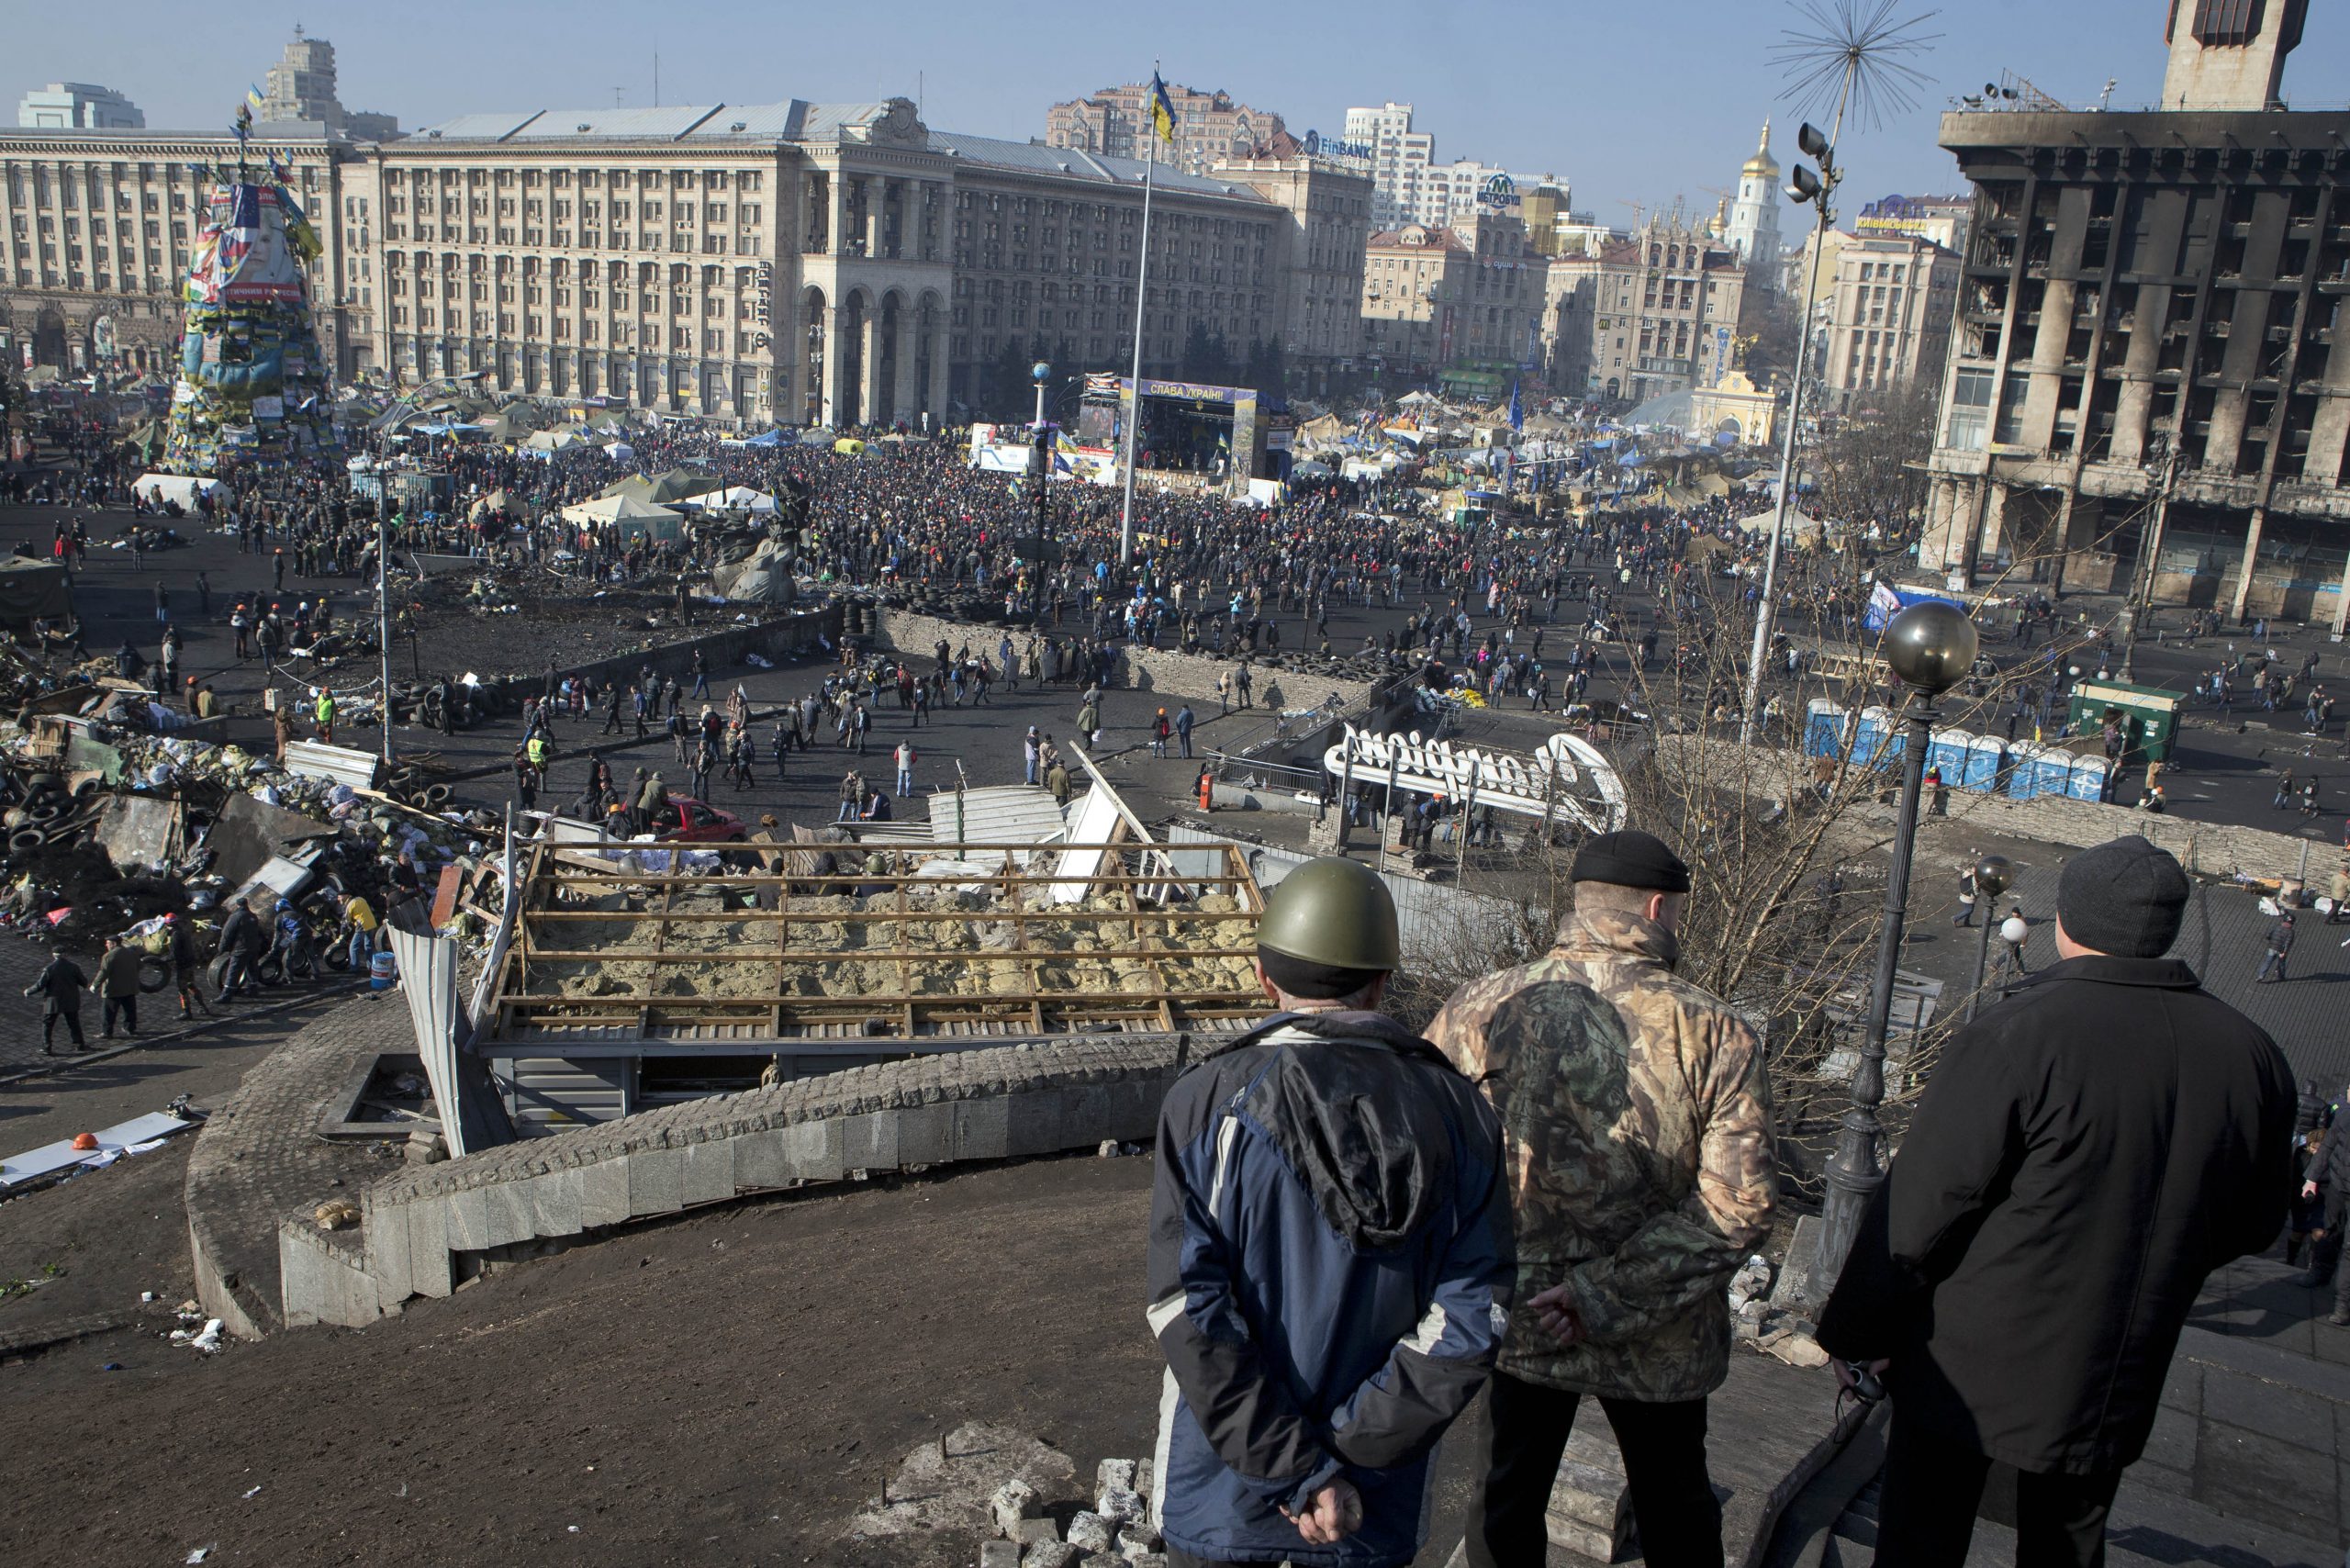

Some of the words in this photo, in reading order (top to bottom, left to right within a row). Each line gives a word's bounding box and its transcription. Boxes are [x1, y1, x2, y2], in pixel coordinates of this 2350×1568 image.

[1321, 137, 1372, 161] FinBANK
[1476, 191, 1521, 207] МЕТРОБУД
[1150, 384, 1183, 397] СЛАВА
[1186, 387, 1224, 401] УКРАЇНІ!
